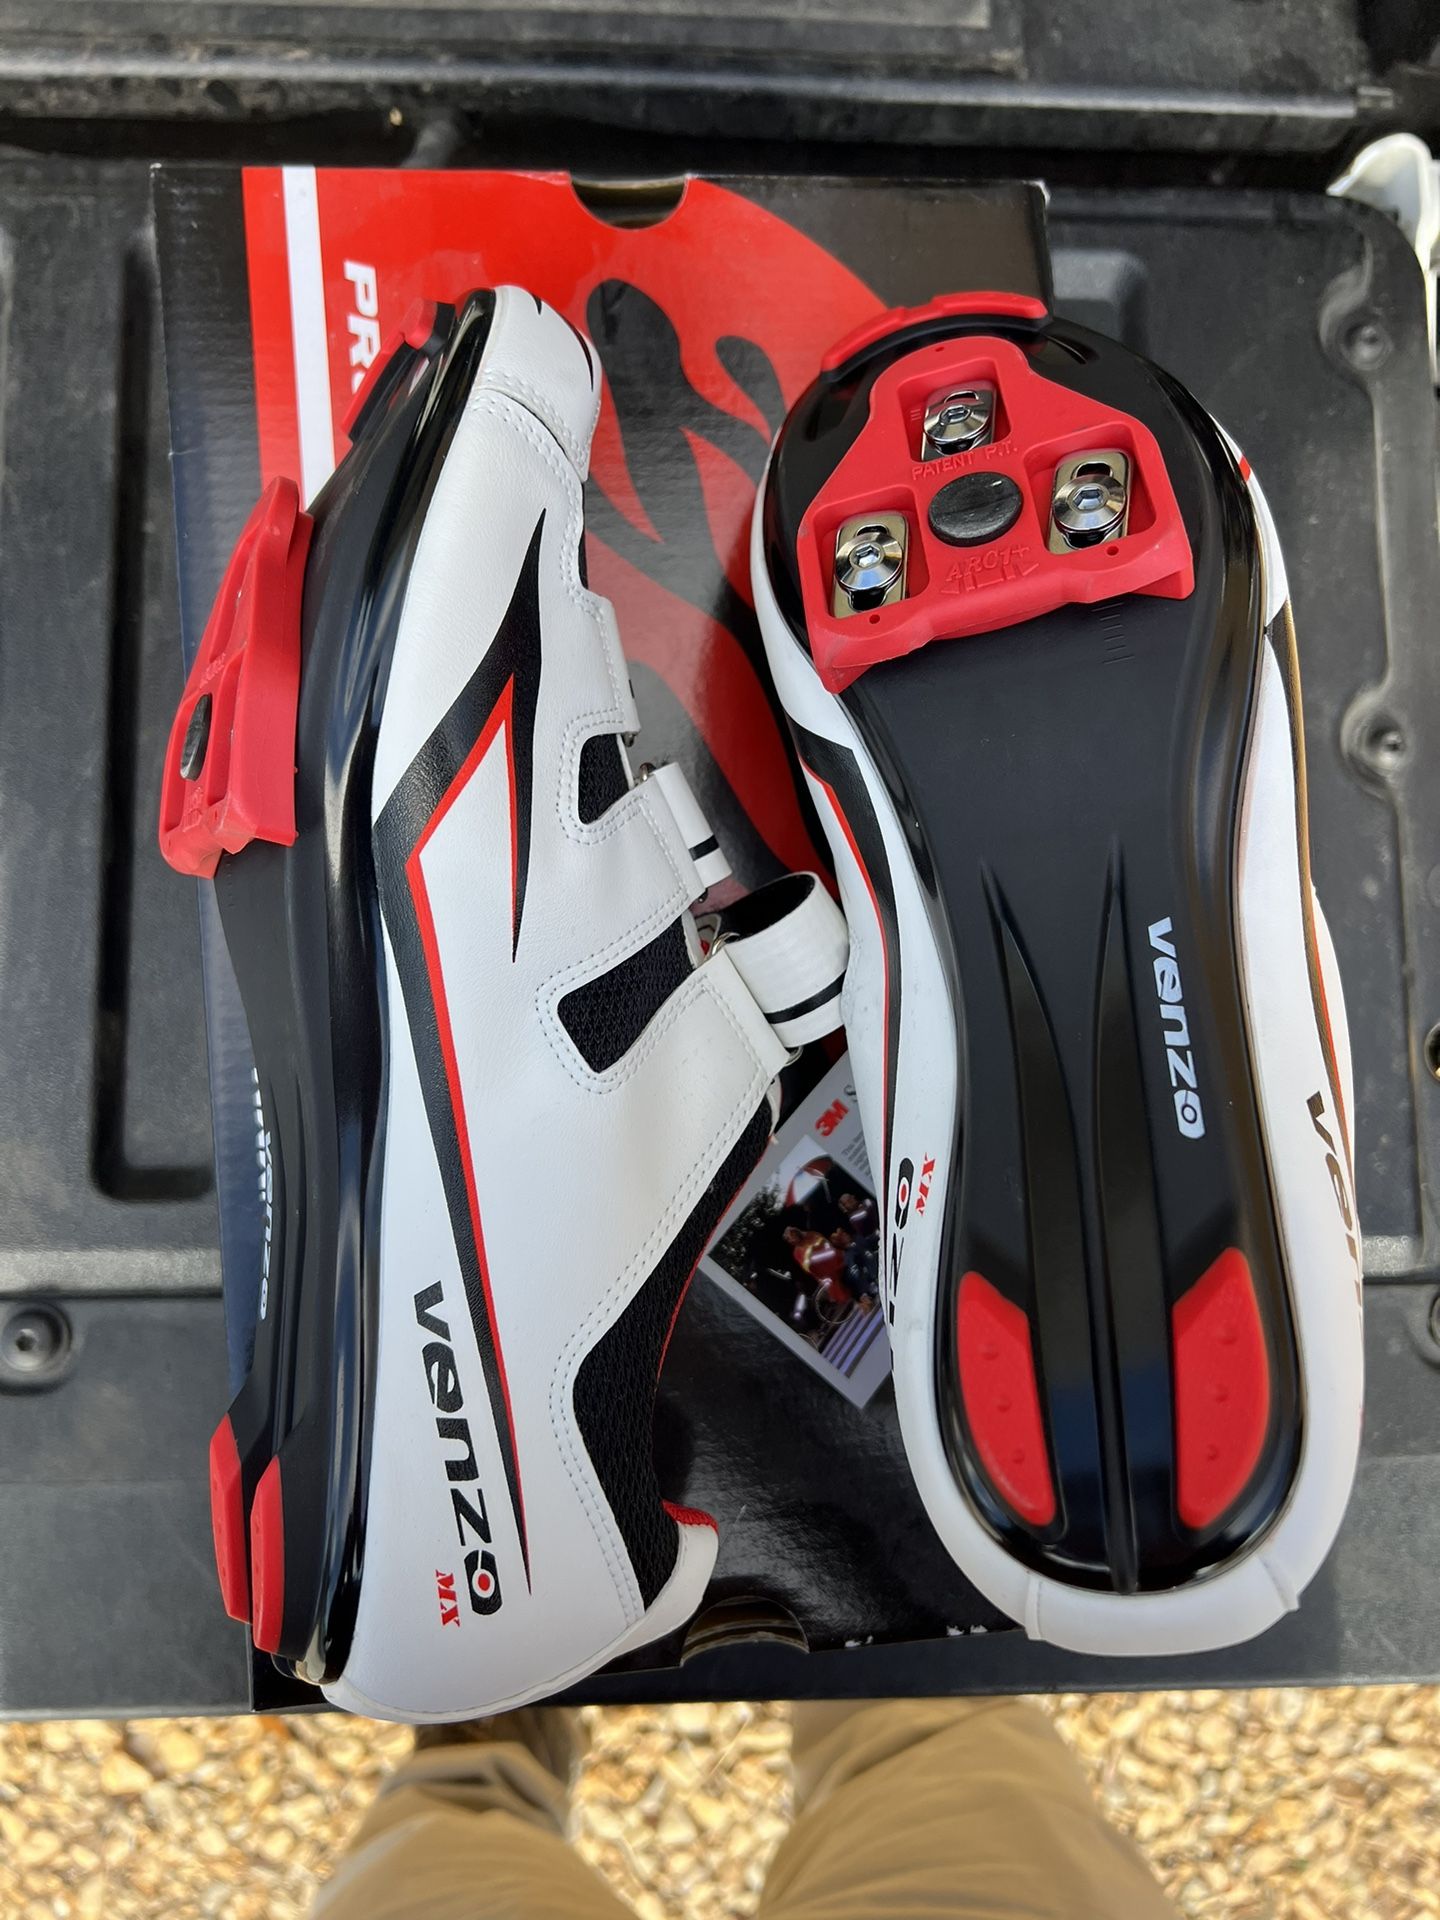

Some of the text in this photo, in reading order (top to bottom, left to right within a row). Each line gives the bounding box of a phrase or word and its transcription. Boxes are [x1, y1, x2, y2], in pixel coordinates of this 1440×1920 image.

[911, 451, 976, 481] PATENT
[815, 1098, 849, 1137] 3M
[915, 1152, 936, 1217] MX
[435, 1568, 461, 1628] MX
